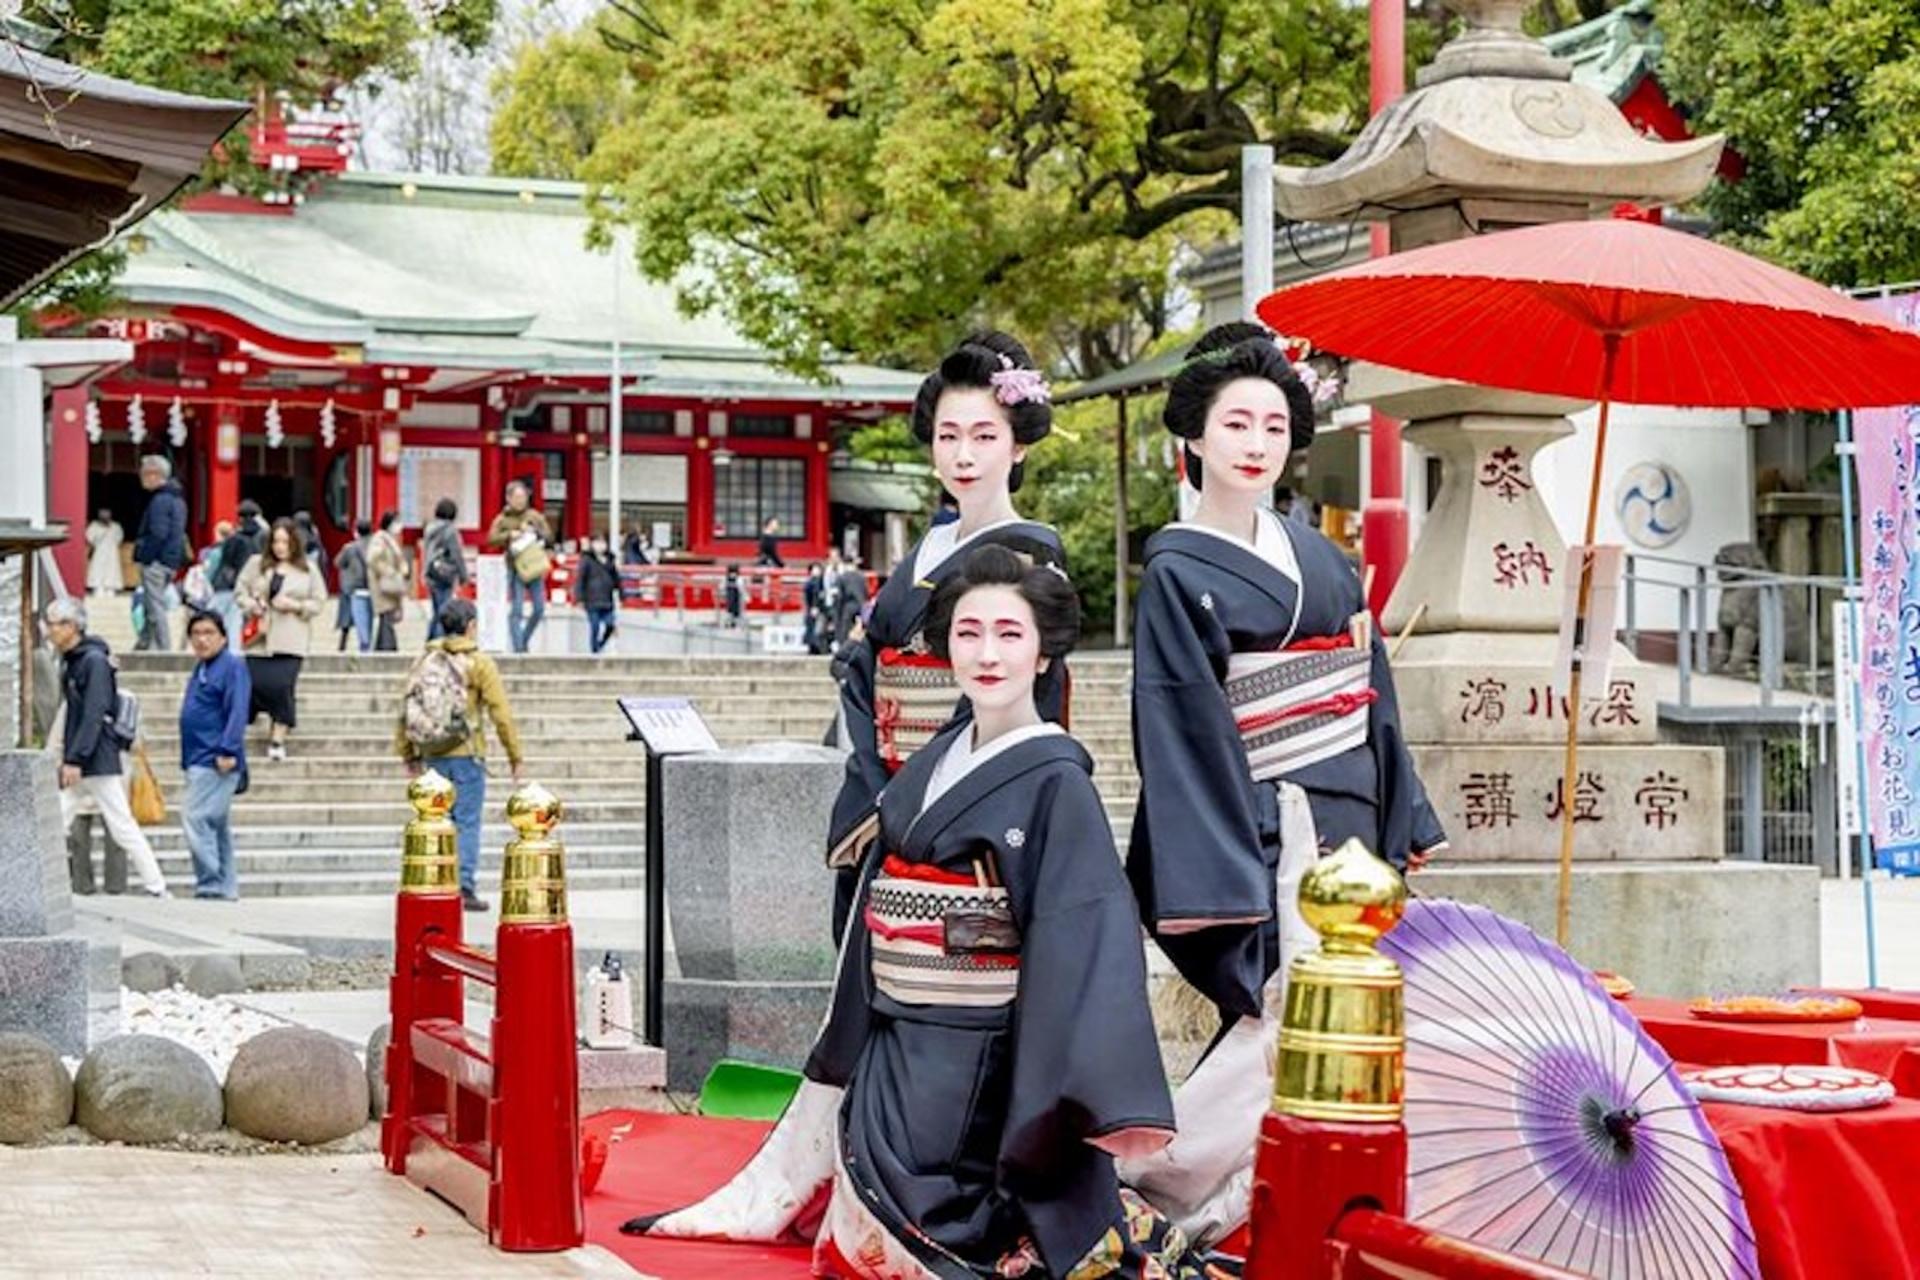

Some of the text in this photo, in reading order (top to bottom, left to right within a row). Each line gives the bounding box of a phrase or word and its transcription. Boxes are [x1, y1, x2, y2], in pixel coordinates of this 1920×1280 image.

[1871, 510, 1914, 837] 和船から眺めるお花見
